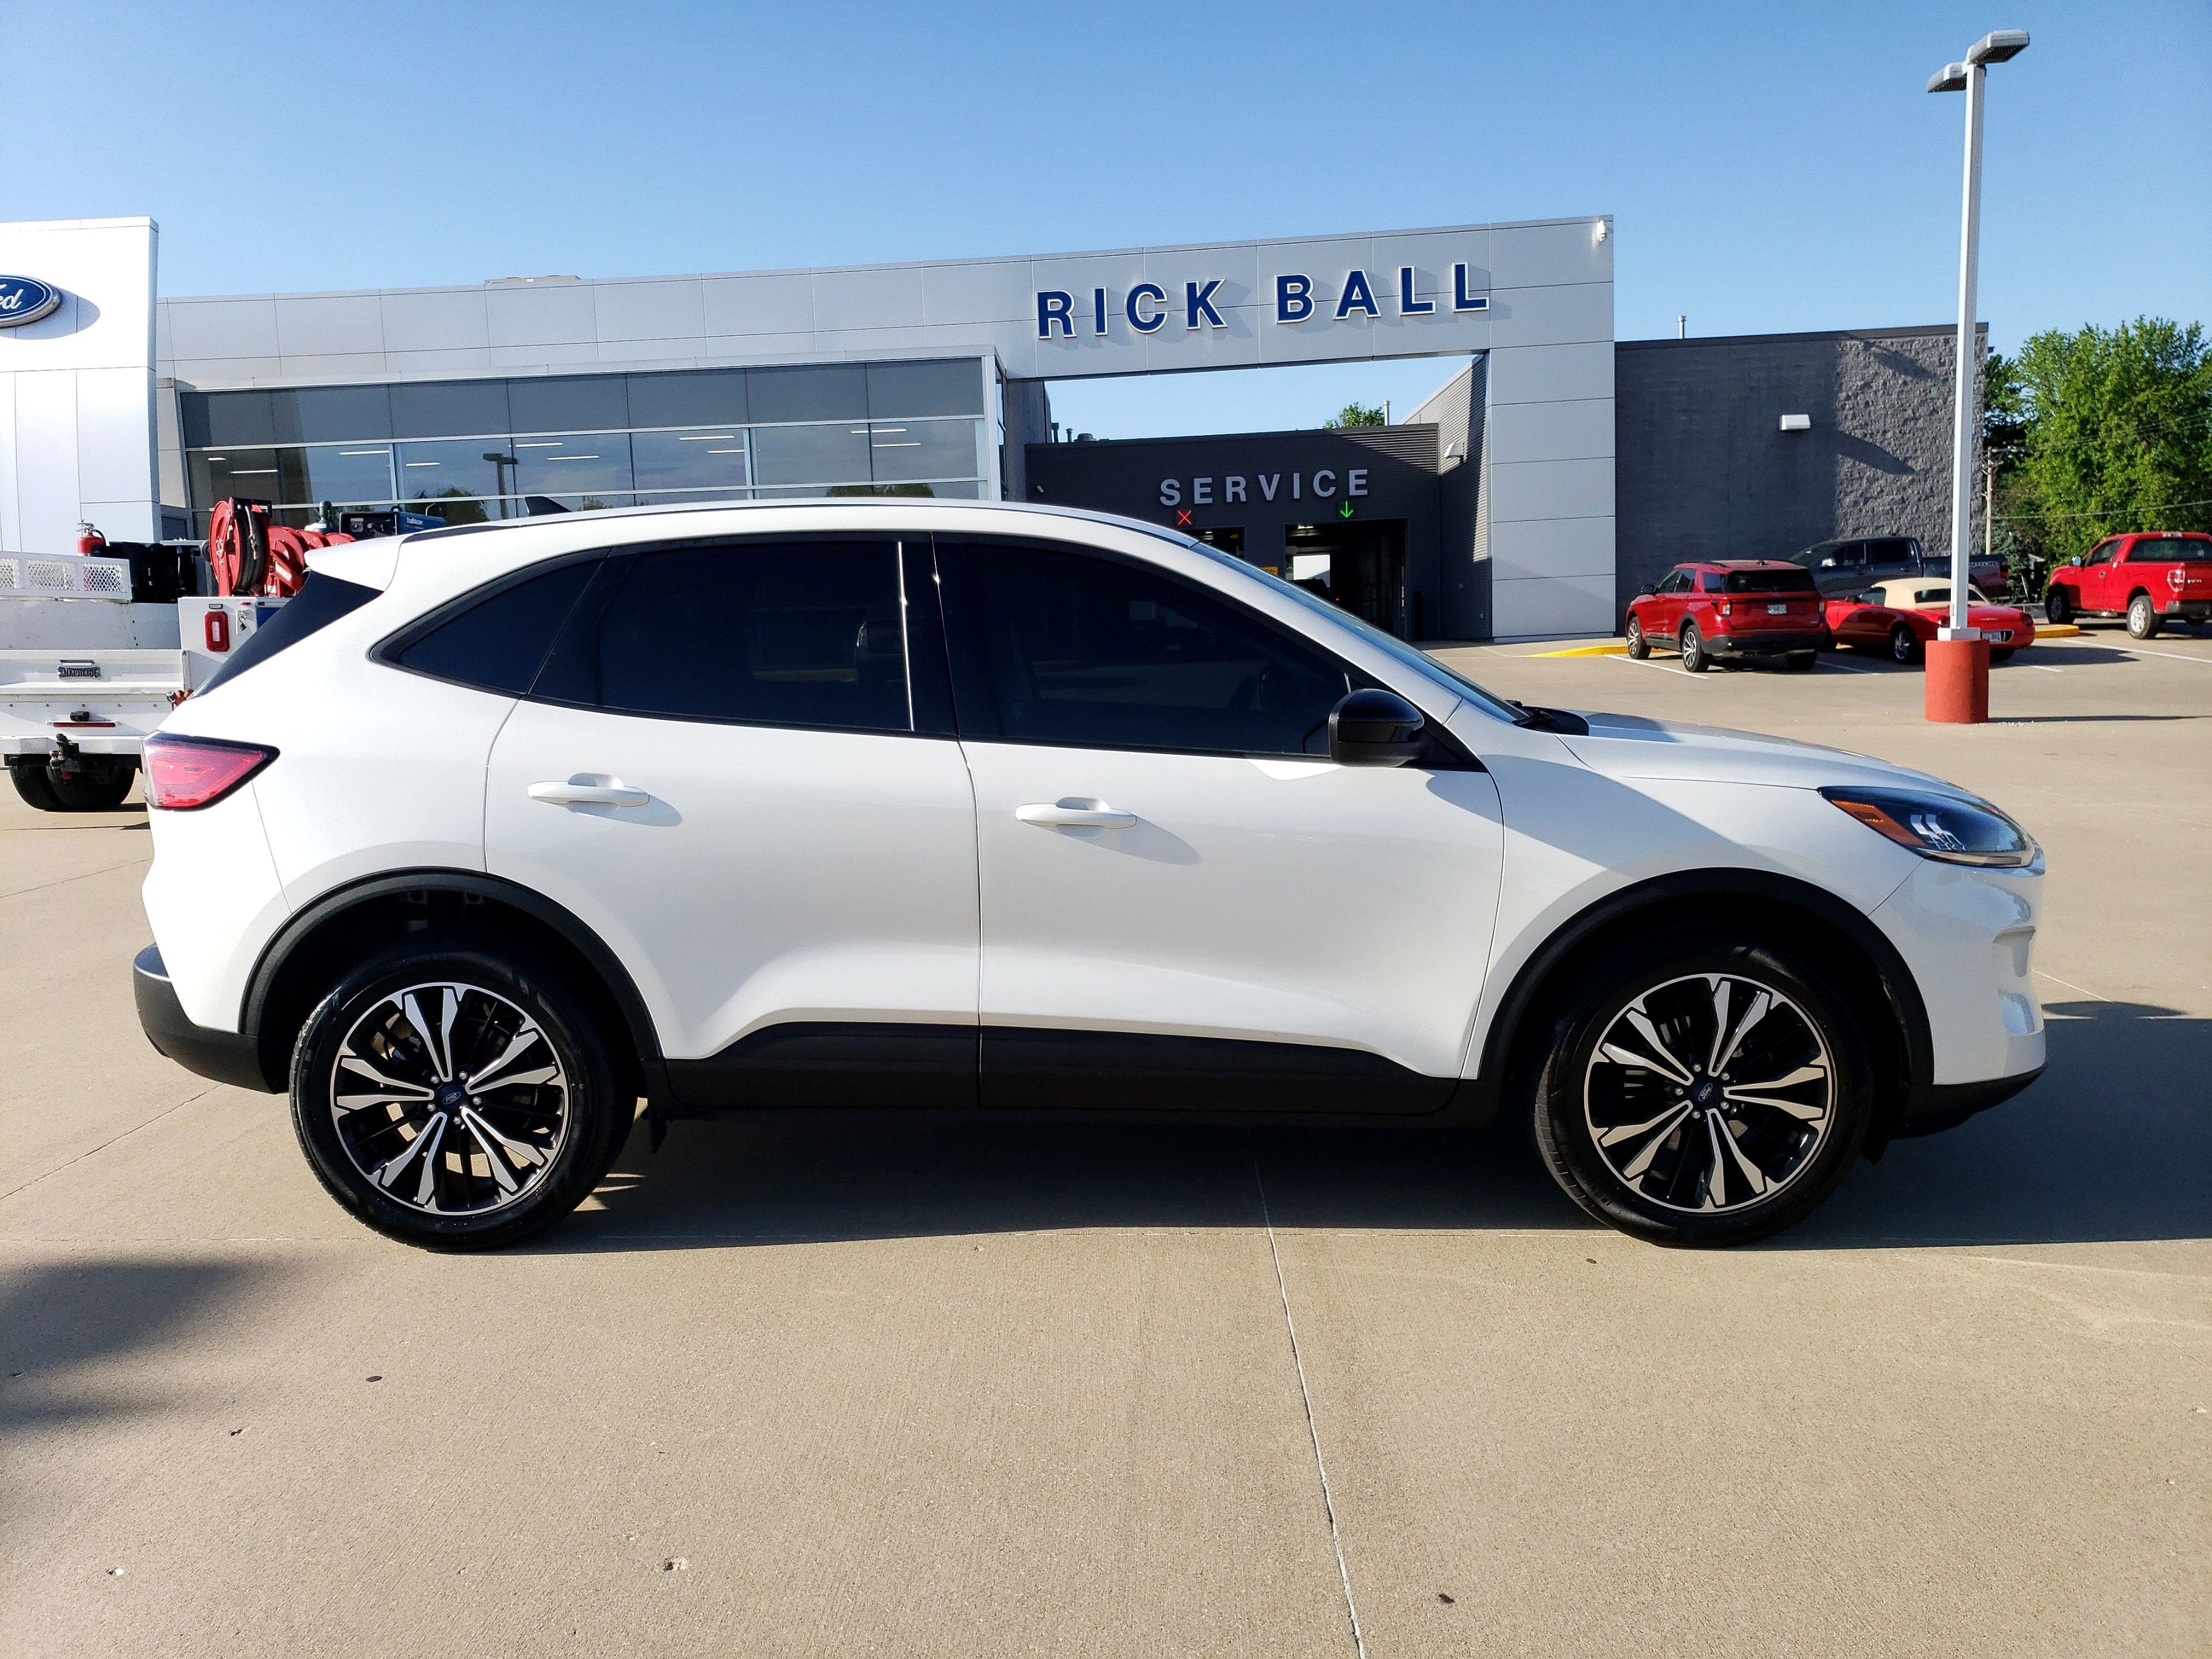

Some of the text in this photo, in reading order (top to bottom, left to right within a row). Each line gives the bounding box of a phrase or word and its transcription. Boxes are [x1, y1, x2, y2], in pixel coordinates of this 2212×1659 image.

[1037, 262, 1489, 339] RICK BALL
[1160, 469, 1367, 506] SERVICE
